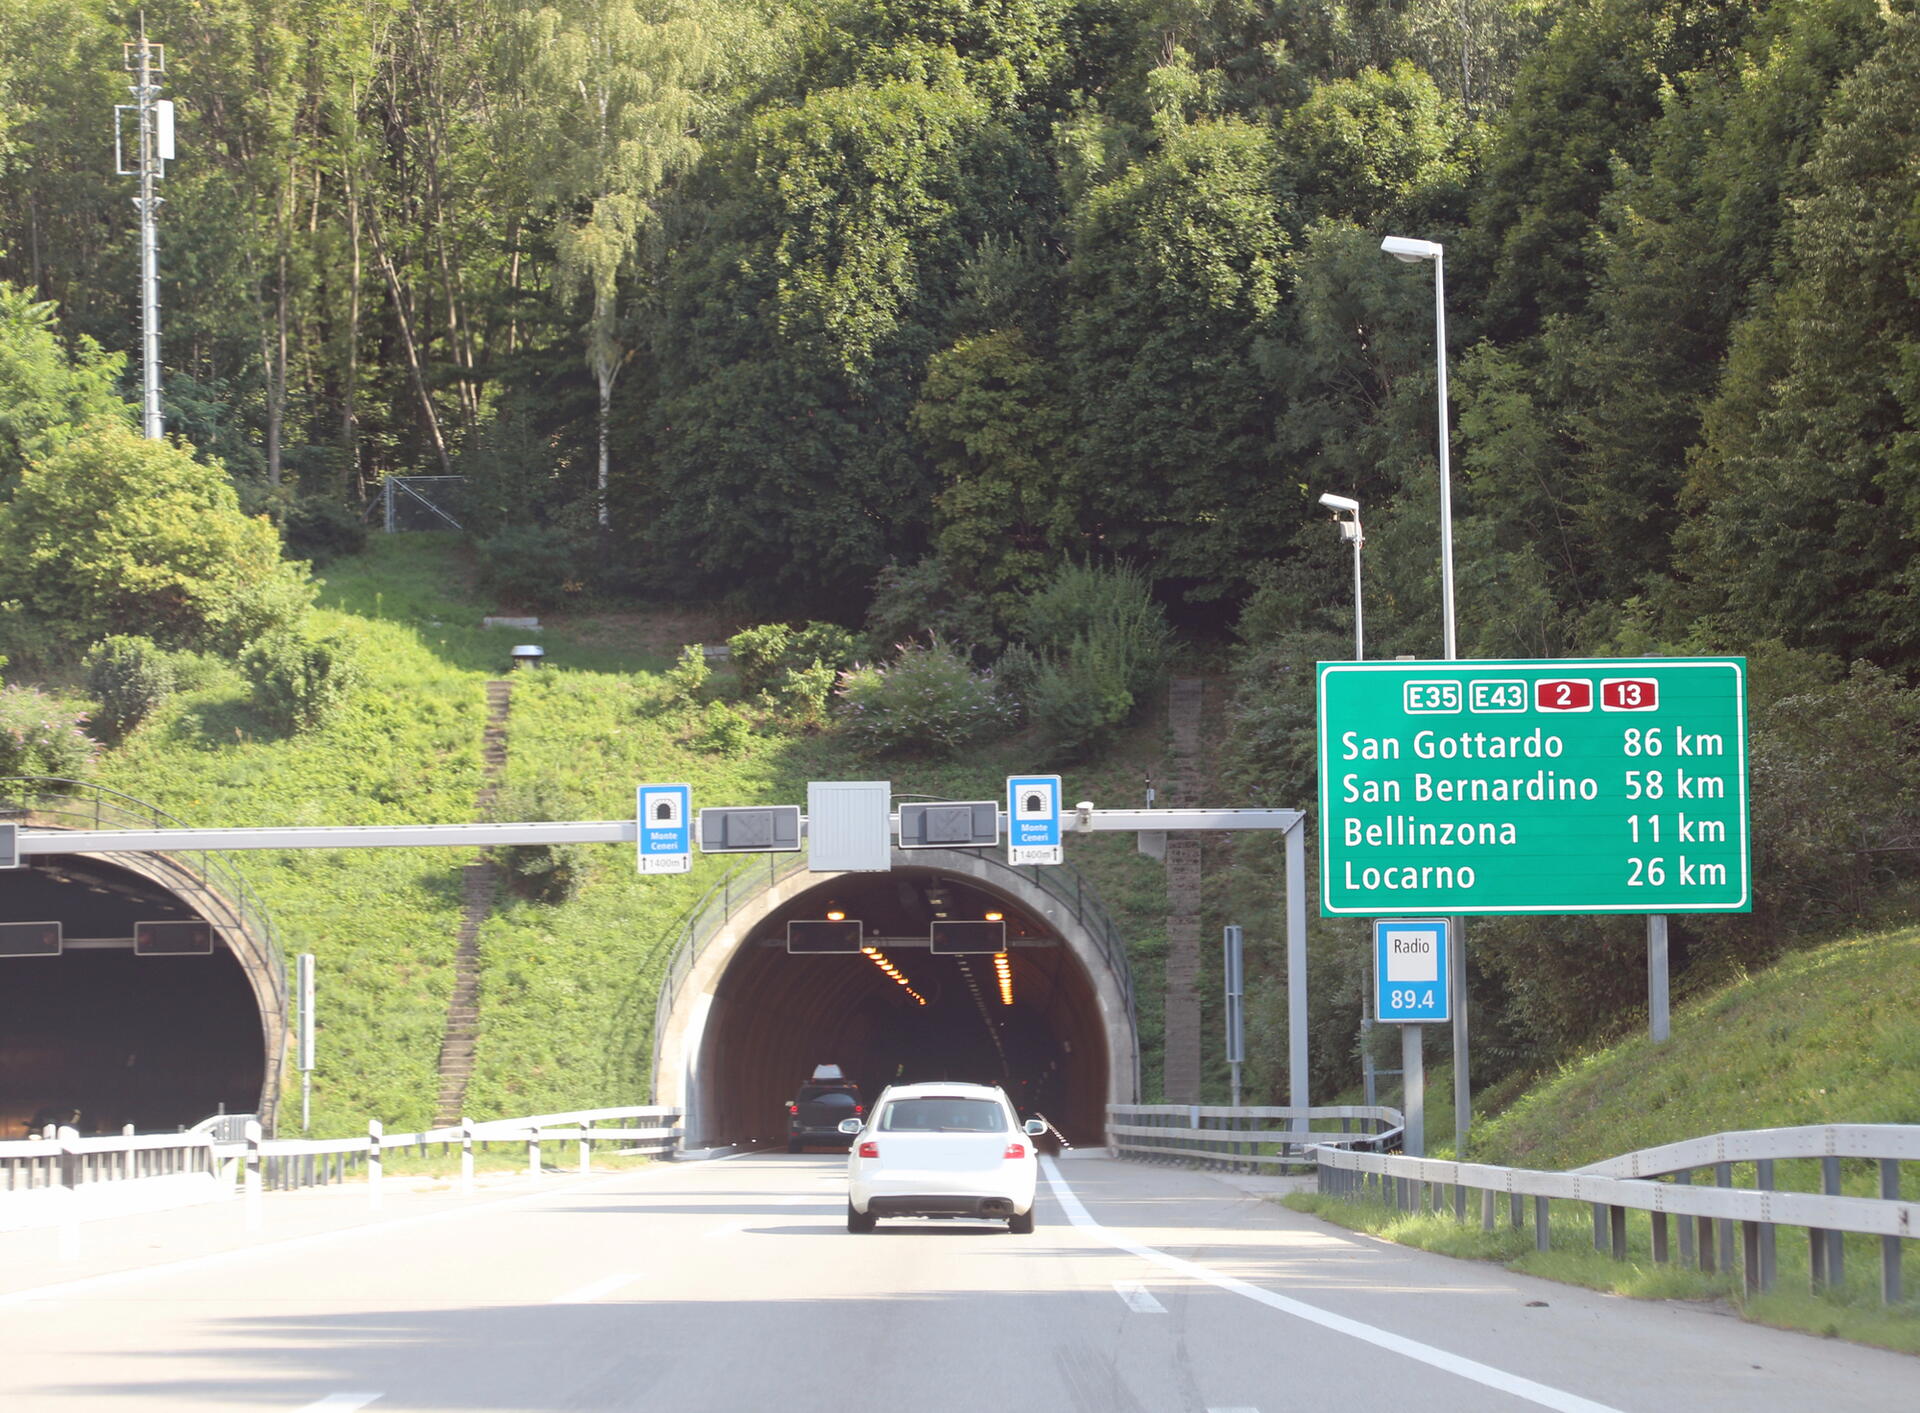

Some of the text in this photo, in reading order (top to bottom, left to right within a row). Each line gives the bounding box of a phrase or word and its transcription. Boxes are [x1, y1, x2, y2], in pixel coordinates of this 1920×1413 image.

[1409, 684, 1642, 709] E35 E43 2 13
[1342, 725, 1723, 760] San Gottardo 86 km
[1343, 768, 1724, 803] San Bernardino 58 km
[650, 832, 678, 840] Monte
[1021, 823, 1048, 832] Monte
[1022, 833, 1048, 841] Ceneri
[1344, 812, 1725, 847] Bellinzona 11 km
[651, 841, 678, 850] Ceneri
[1345, 855, 1727, 890] Locarno 26 km
[1394, 938, 1430, 953] Radio
[1391, 989, 1435, 1009] 89.4
